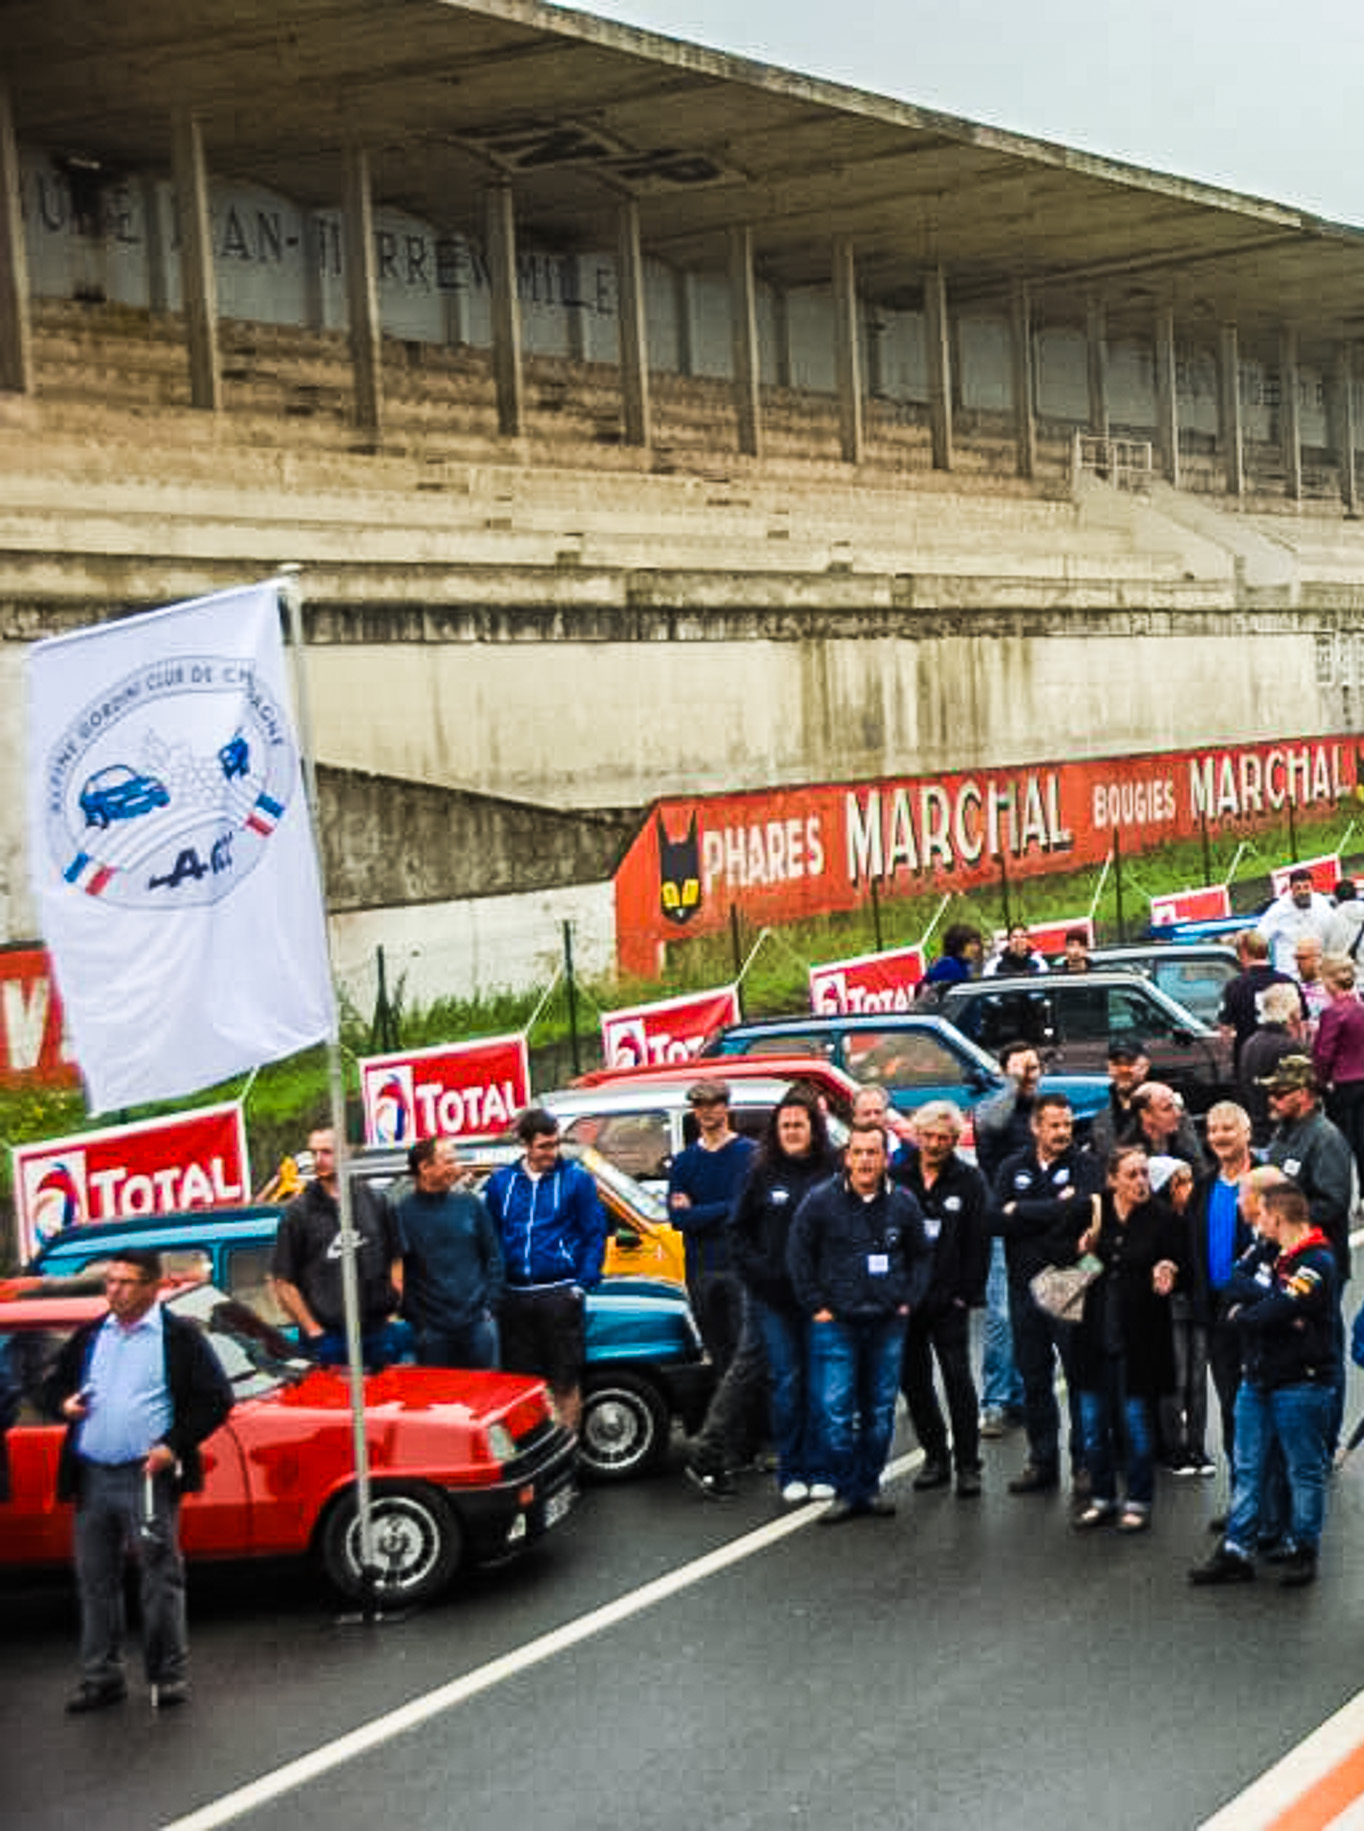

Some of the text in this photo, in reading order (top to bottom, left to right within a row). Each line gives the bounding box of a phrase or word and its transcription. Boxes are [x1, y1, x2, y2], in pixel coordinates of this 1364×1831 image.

[147, 667, 184, 691] CLUB
[191, 665, 213, 685] DE
[703, 745, 1353, 894] PHARES MARCHAL BOUGIES MARCHAL
[415, 1080, 526, 1137] TOTAL
[90, 1157, 241, 1219] TOTAL
